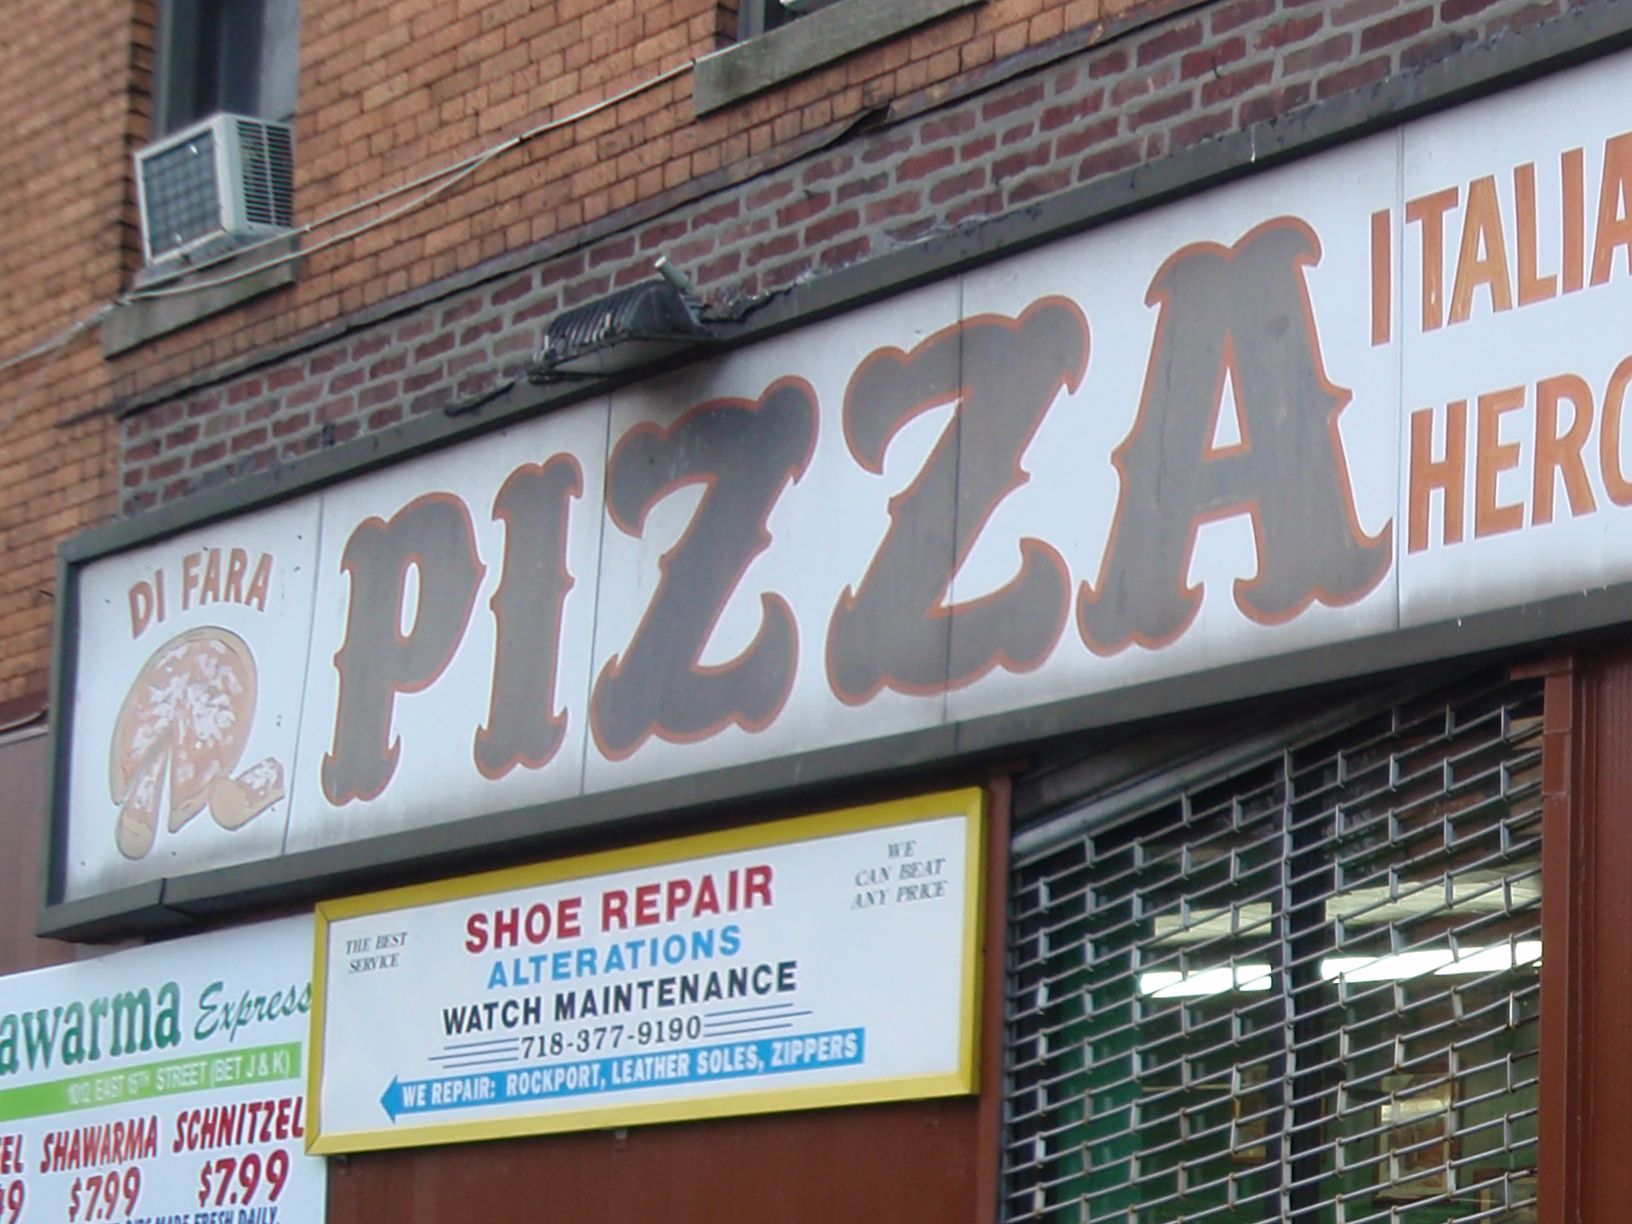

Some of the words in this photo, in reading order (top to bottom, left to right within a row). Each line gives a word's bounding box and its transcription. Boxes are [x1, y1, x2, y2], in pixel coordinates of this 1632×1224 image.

[321, 216, 1392, 805] PIZZA
[129, 569, 165, 639] DI
[181, 548, 274, 612] FARA
[855, 866, 892, 886] CAN
[900, 858, 946, 879] BEAT
[888, 840, 917, 858] WE
[466, 896, 582, 954] SHOE
[602, 864, 773, 930] REPAIR
[850, 888, 889, 909] ANY
[897, 880, 948, 902] PRICE
[346, 937, 371, 955] THE
[376, 931, 408, 949] BEST
[348, 953, 400, 974] SERVICE
[487, 924, 741, 989] ALTERATIONS
[0, 981, 182, 1075] awarma
[195, 980, 310, 1042] Express
[443, 991, 541, 1036] WATCH
[554, 961, 797, 1022] MAINTENANCE
[156, 1062, 207, 1090] STREET
[210, 1056, 242, 1087] (BET
[258, 1052, 268, 1076] &
[402, 1082, 427, 1107] WE
[431, 1077, 496, 1105] REPAIR:
[506, 1064, 607, 1098] ROCKPORT,
[612, 1051, 689, 1085] LEATHER
[697, 1045, 764, 1078] SOLES,
[771, 1033, 858, 1066] ZIPPERS
[520, 1015, 701, 1060] 718-377-9190
[40, 1115, 157, 1173] SHAWARMA
[172, 1096, 304, 1153] SCHNITZEL
[69, 1166, 141, 1223] $7.99
[198, 1149, 289, 1207] $7.99
